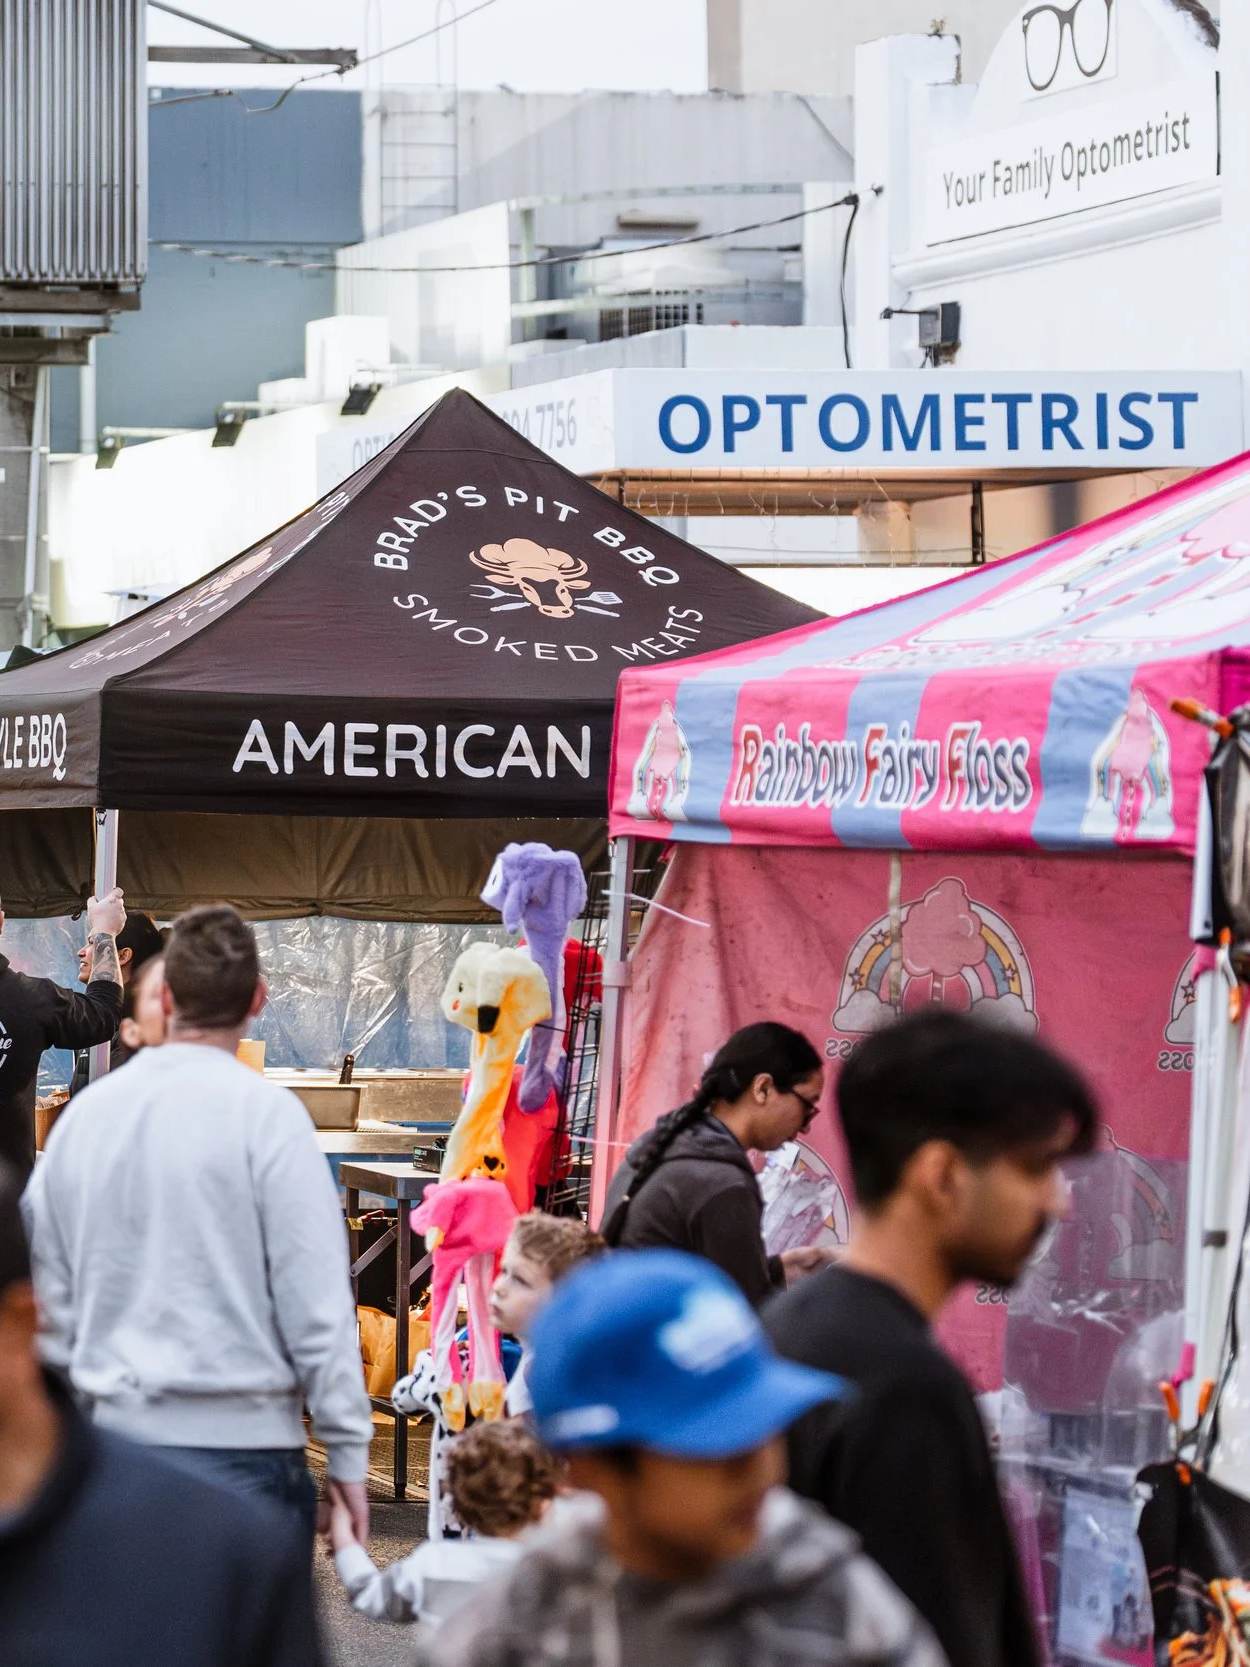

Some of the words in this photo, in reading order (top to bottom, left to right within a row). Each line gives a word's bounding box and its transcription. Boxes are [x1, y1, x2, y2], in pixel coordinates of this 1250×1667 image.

[943, 170, 986, 209] Your
[993, 146, 1054, 200] Family
[1061, 111, 1191, 192] Optometrist
[536, 398, 577, 450] 7756
[658, 392, 1200, 454] OPTOMETRIST
[373, 485, 488, 571] BRAD'S
[503, 486, 580, 522] PIT
[593, 526, 680, 587] BBQ
[393, 593, 599, 662] SMOKED
[611, 605, 704, 661] MEATS
[28, 712, 68, 781] BBQ
[232, 718, 592, 778] AMERICAN
[730, 723, 858, 808] Rainbow
[855, 721, 941, 810] Fairy
[940, 720, 1034, 813] Floss
